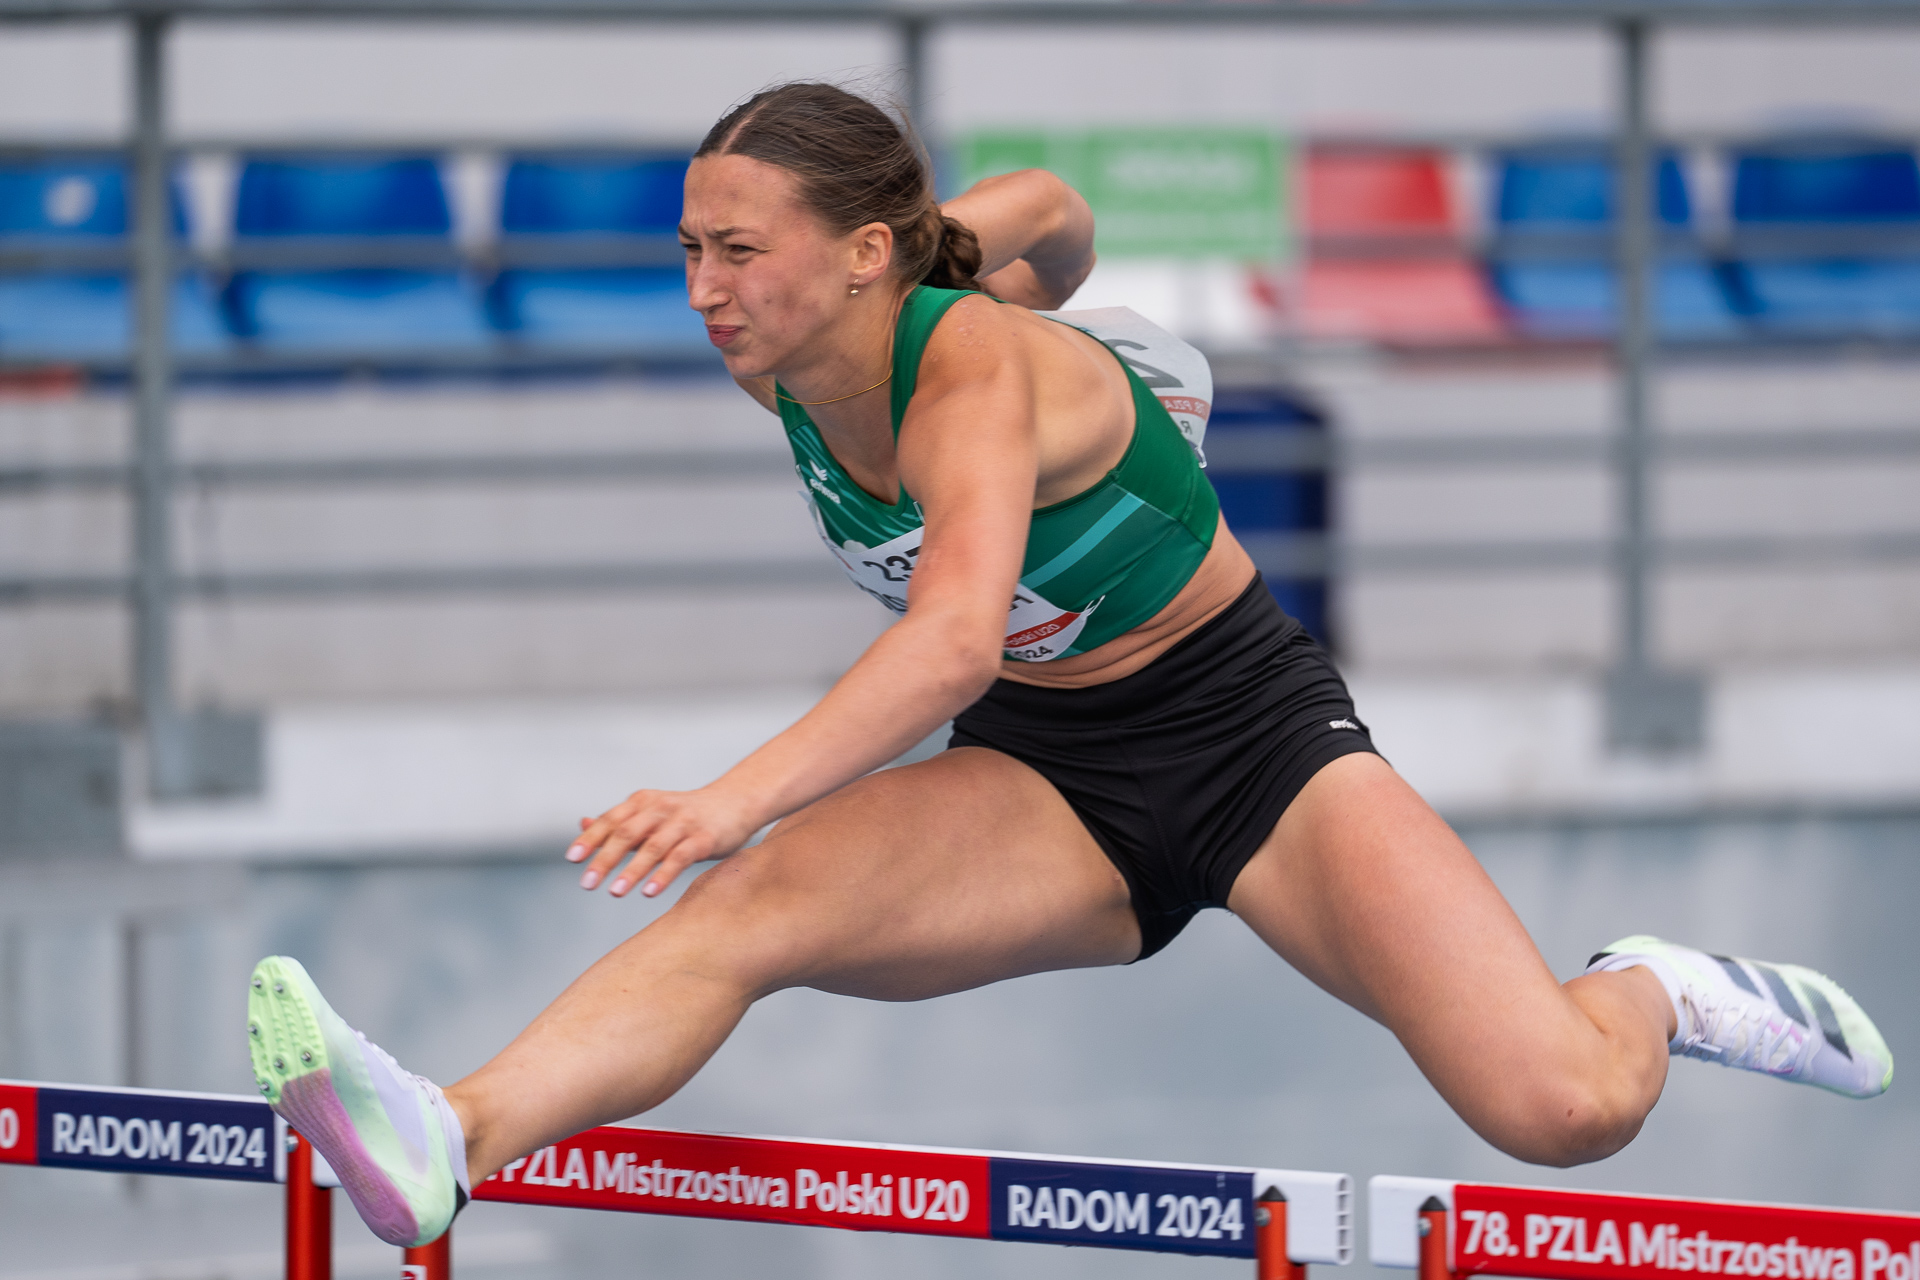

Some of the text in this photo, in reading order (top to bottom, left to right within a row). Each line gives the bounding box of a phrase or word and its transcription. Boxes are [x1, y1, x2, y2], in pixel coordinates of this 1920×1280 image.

[1034, 623, 1061, 639] U20
[53, 1112, 182, 1161] RADOM
[186, 1122, 267, 1168] 2024
[593, 1150, 789, 1208] Mistrzostwa
[795, 1168, 893, 1217] Polski
[898, 1176, 970, 1222] U20
[1007, 1185, 1245, 1241] RADOM 2024
[1461, 1210, 1520, 1257] 78.
[1524, 1213, 1626, 1266] PZLA
[1628, 1221, 1856, 1280] Mistrzostwa
